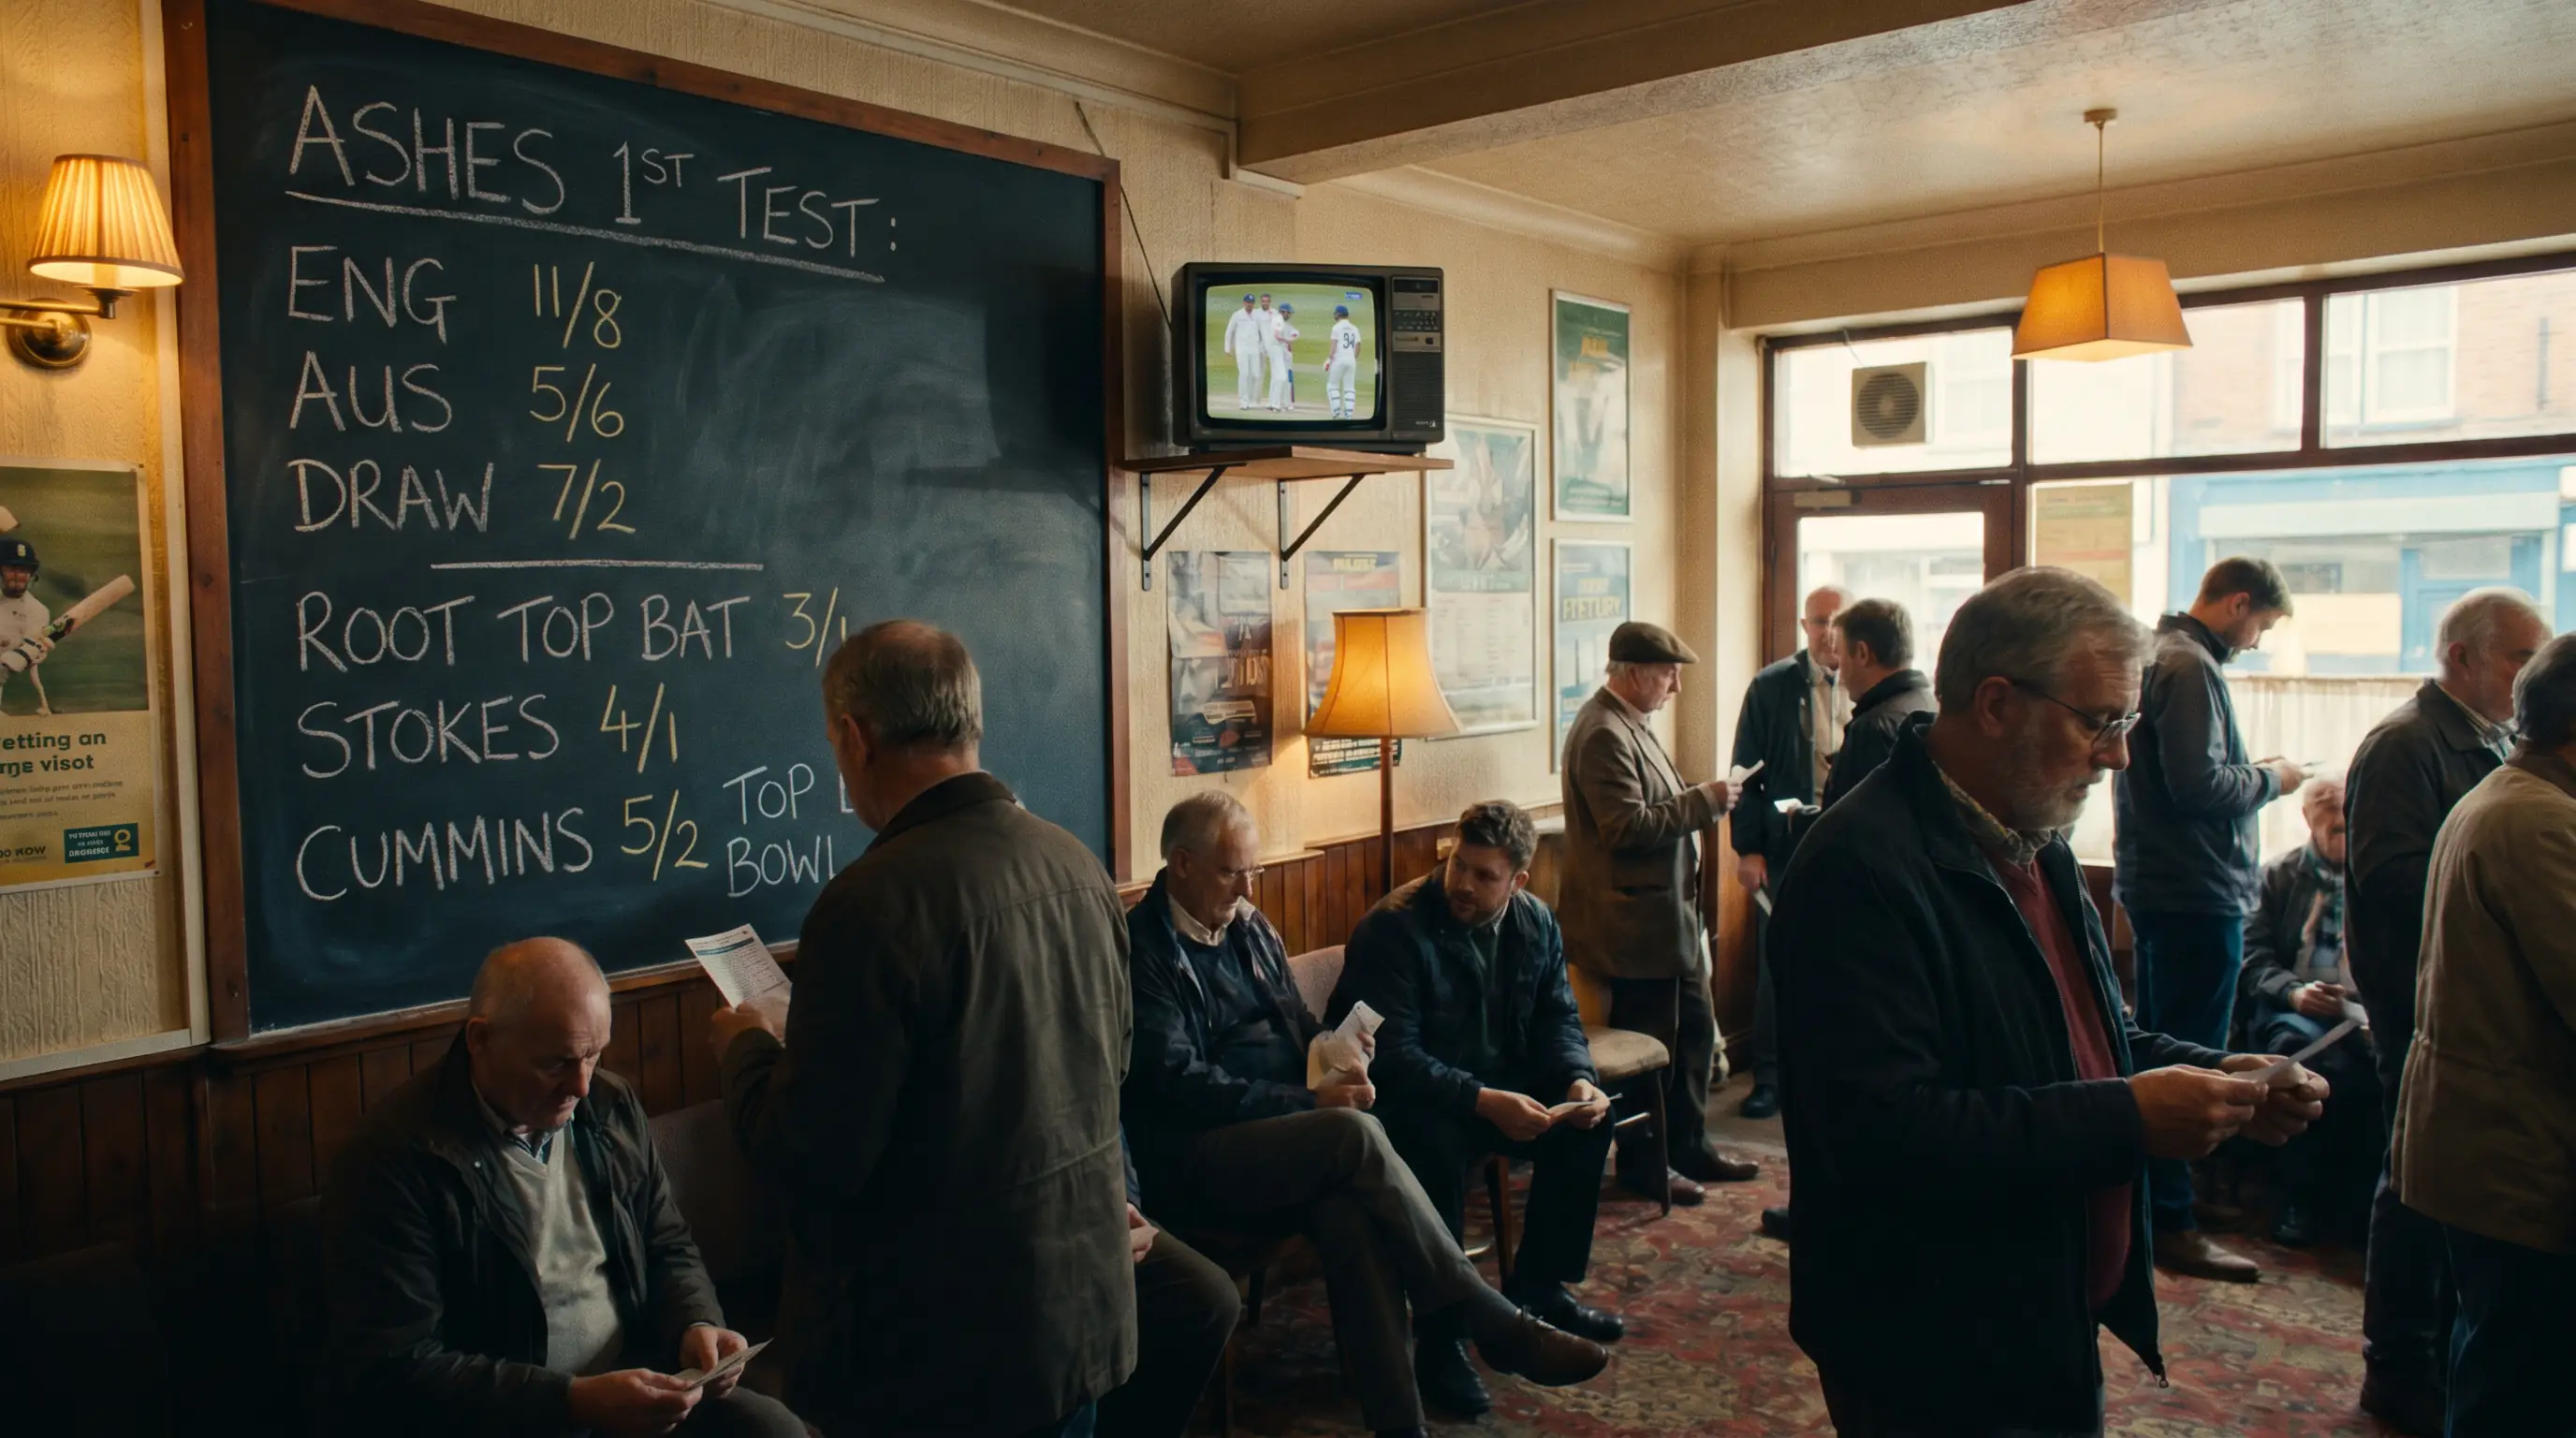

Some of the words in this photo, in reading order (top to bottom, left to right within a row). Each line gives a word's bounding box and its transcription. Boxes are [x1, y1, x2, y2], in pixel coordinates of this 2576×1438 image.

[288, 85, 564, 214] ASHES
[613, 141, 694, 225] 1ST
[288, 245, 457, 344] ENG
[534, 262, 622, 348] 11/8
[290, 351, 452, 433] AUS
[530, 363, 624, 442] 5/6
[288, 459, 494, 533] DRAW
[537, 459, 636, 539] 7/2
[297, 592, 476, 672] ROOT
[497, 593, 615, 662] TOP
[640, 594, 751, 662] BAT
[79, 732, 107, 745] an
[298, 694, 560, 778] STOKES
[600, 682, 678, 774] 4/1
[723, 763, 814, 825] TOP
[296, 807, 593, 902] CUMMINS
[621, 790, 710, 881] 5/2
